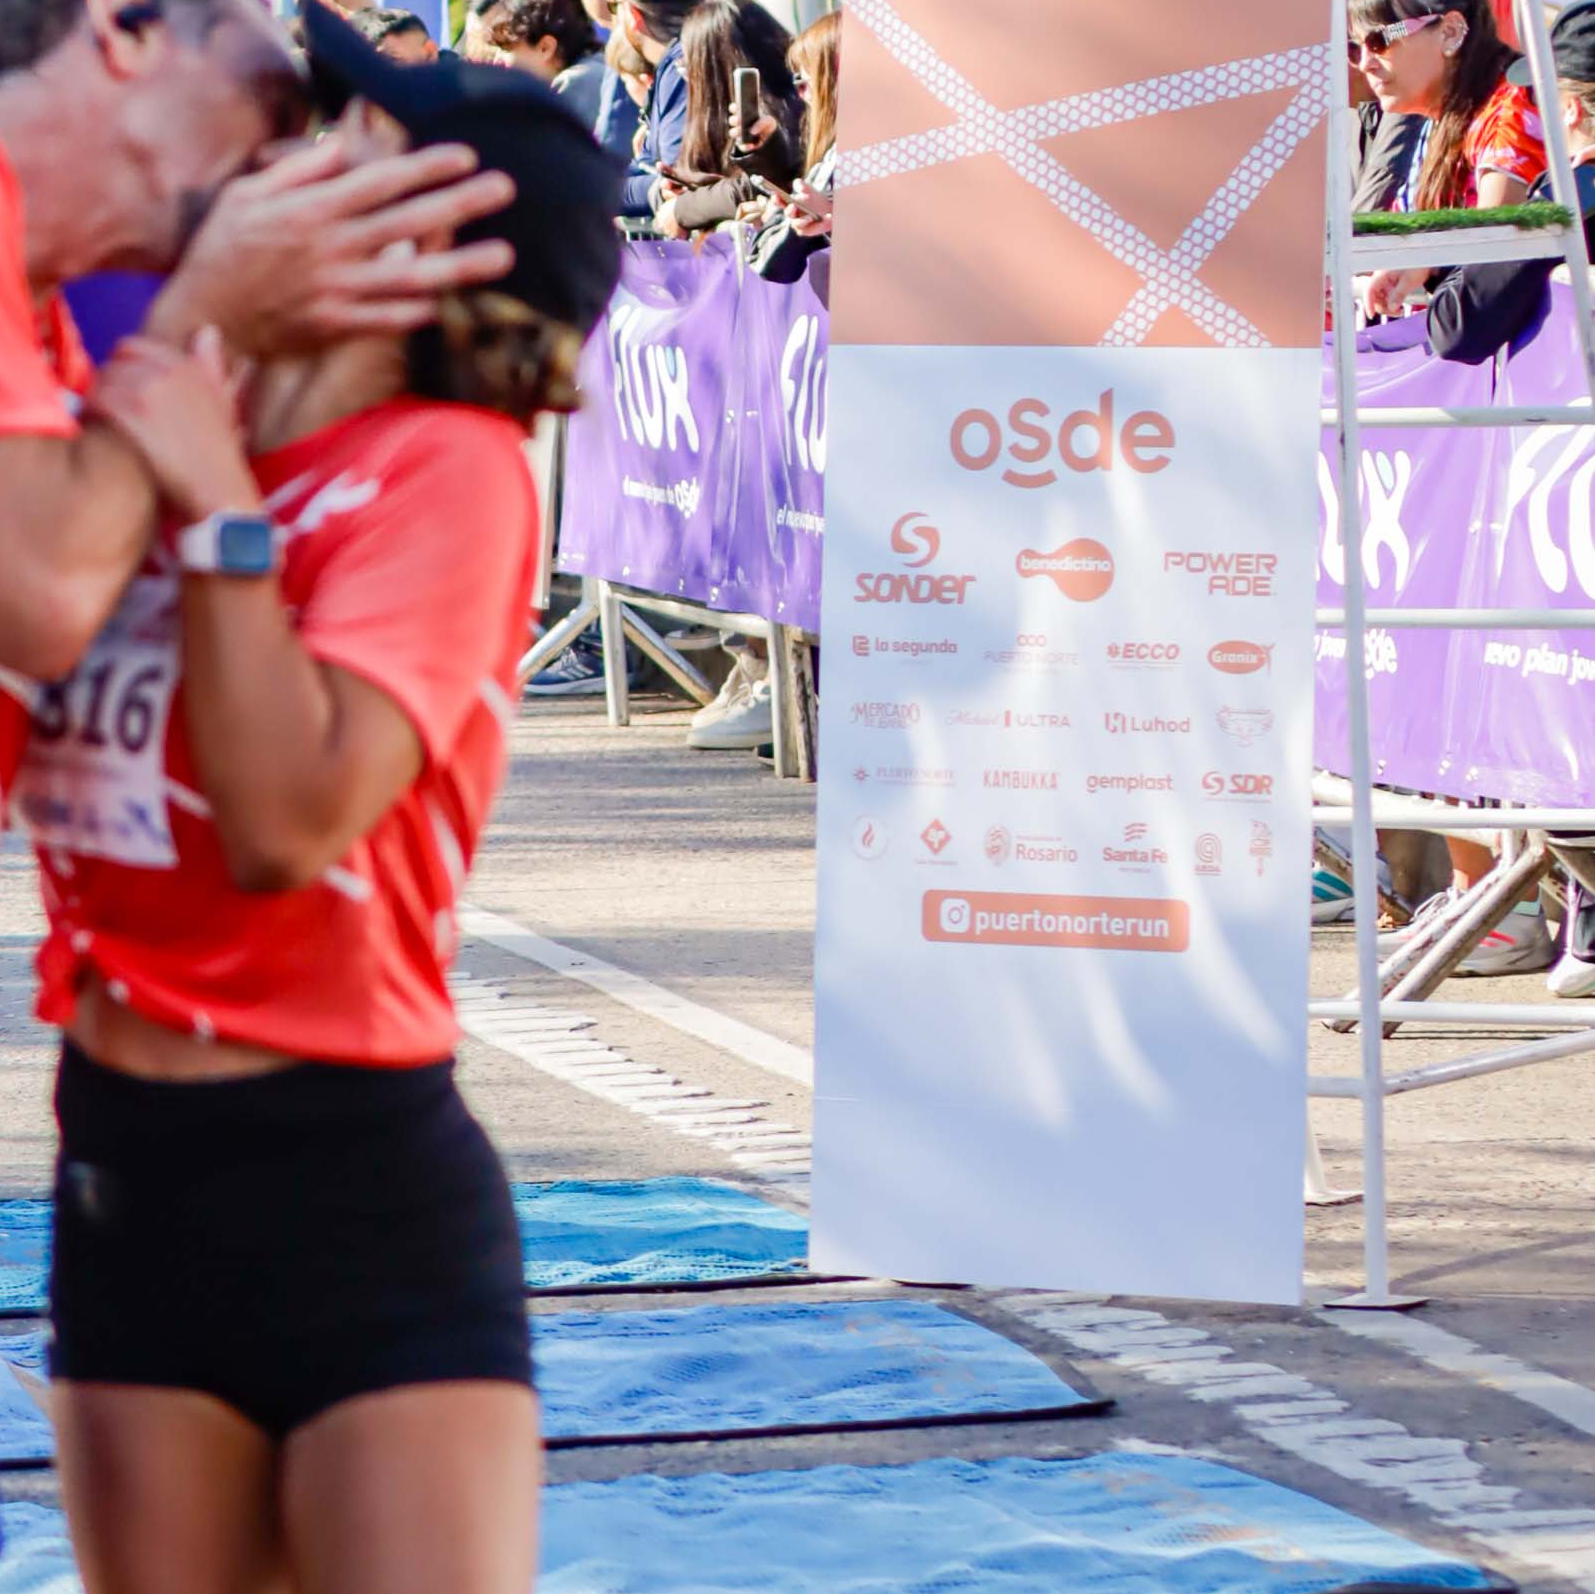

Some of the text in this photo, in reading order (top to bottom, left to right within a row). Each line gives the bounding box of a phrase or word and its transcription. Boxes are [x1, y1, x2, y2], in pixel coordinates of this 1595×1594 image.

[949, 387, 1176, 489] osde
[1164, 552, 1278, 575] POWER
[1208, 575, 1272, 597] ADE
[875, 637, 958, 657] la segunda
[1122, 643, 1181, 661] ECCO
[1017, 713, 1071, 728] ULTRA
[1131, 717, 1191, 734] Luhod
[983, 769, 1060, 790] KAMBUKKA
[1086, 772, 1173, 794] gemplast
[1015, 843, 1079, 863] Rosario
[1102, 846, 1169, 864] Santa Fe
[975, 910, 1170, 939] puertonorterun
